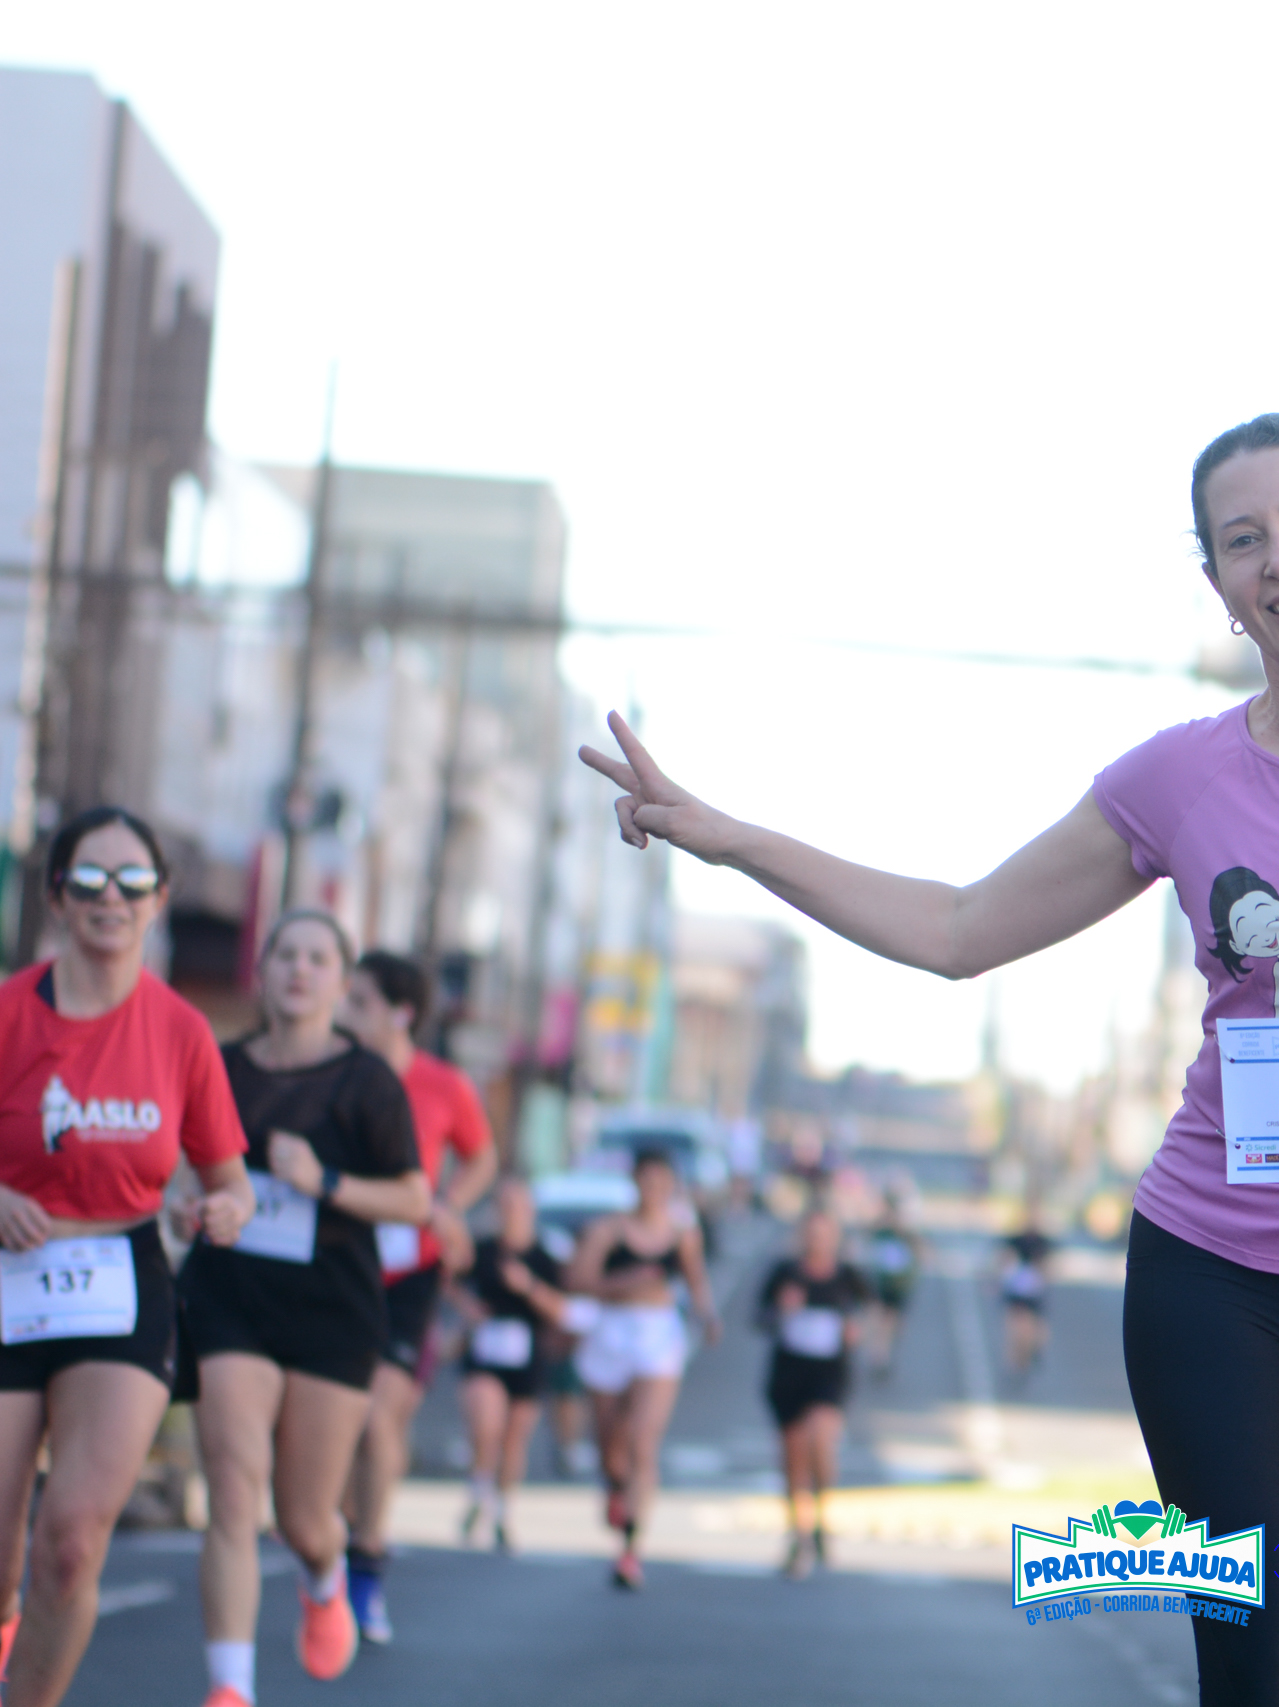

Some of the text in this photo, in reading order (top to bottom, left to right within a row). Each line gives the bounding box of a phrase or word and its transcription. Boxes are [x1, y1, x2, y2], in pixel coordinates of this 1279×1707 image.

[63, 1098, 161, 1132] AASLO
[1254, 1143, 1276, 1151] Sicredi
[39, 1268, 94, 1294] 137
